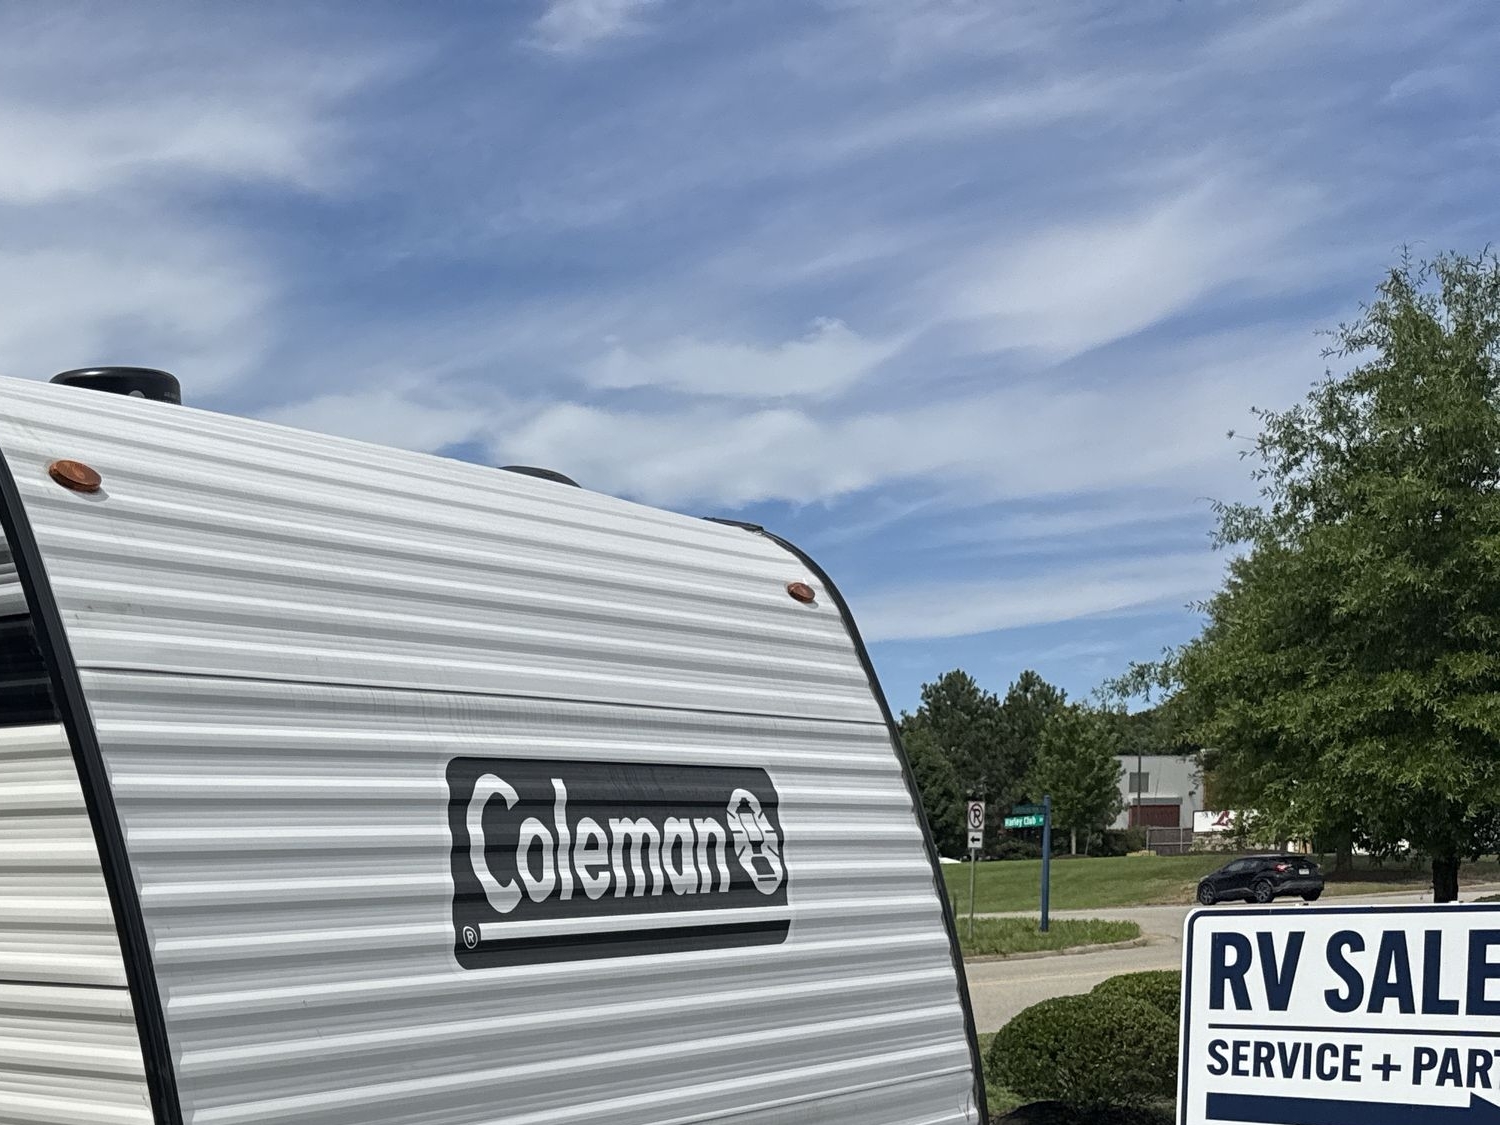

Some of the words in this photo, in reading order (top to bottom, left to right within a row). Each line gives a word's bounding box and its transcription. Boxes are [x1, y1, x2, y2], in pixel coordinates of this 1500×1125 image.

[466, 773, 730, 914] Coleman
[1209, 931, 1306, 1011] RV
[1206, 1039, 1363, 1083] SERVICE
